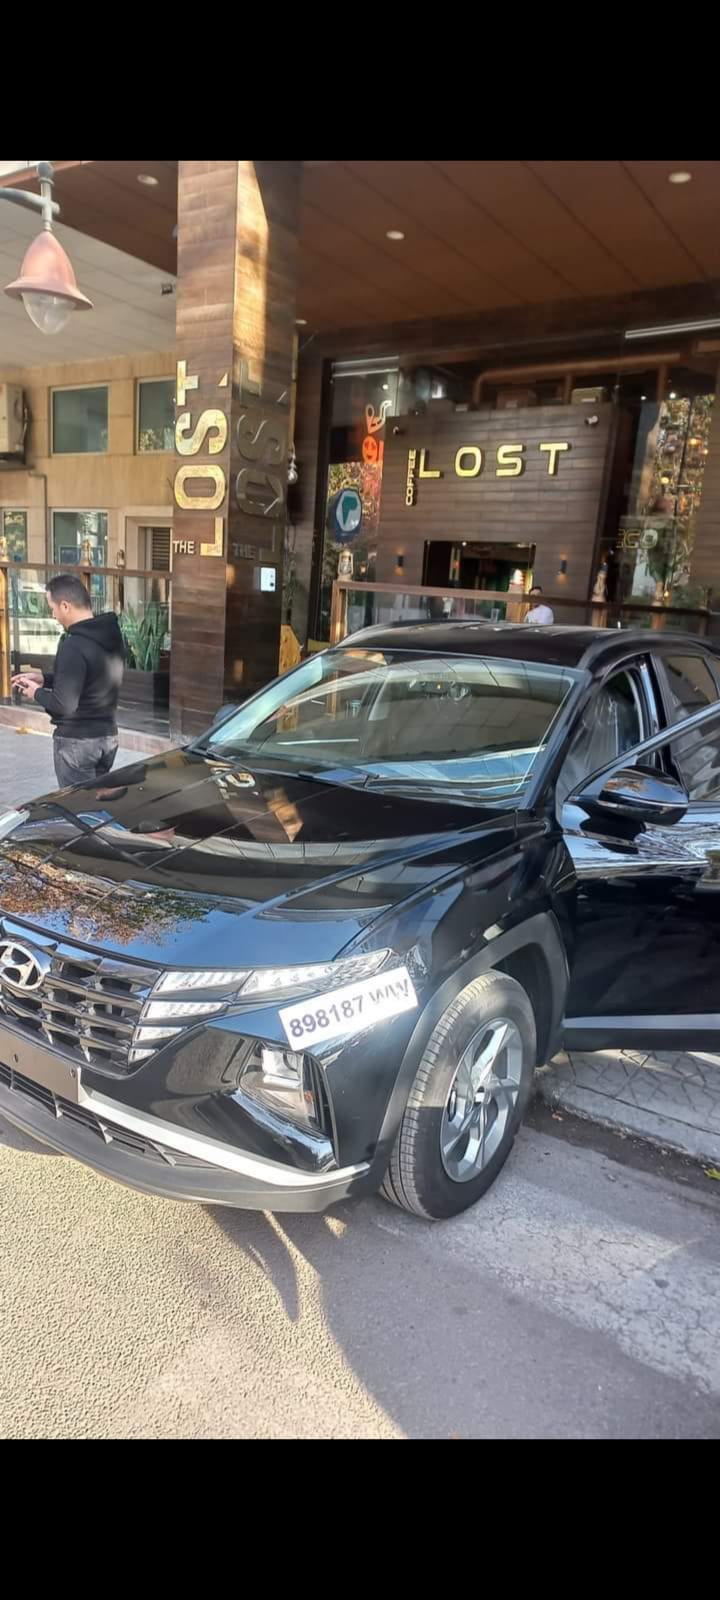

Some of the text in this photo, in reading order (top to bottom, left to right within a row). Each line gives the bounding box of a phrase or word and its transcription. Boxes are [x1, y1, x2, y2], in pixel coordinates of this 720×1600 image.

[172, 359, 228, 557] THE LOST
[405, 448, 417, 506] COFFEE
[419, 442, 570, 479] LOST
[232, 543, 256, 560] THE
[289, 994, 364, 1038] 898187
